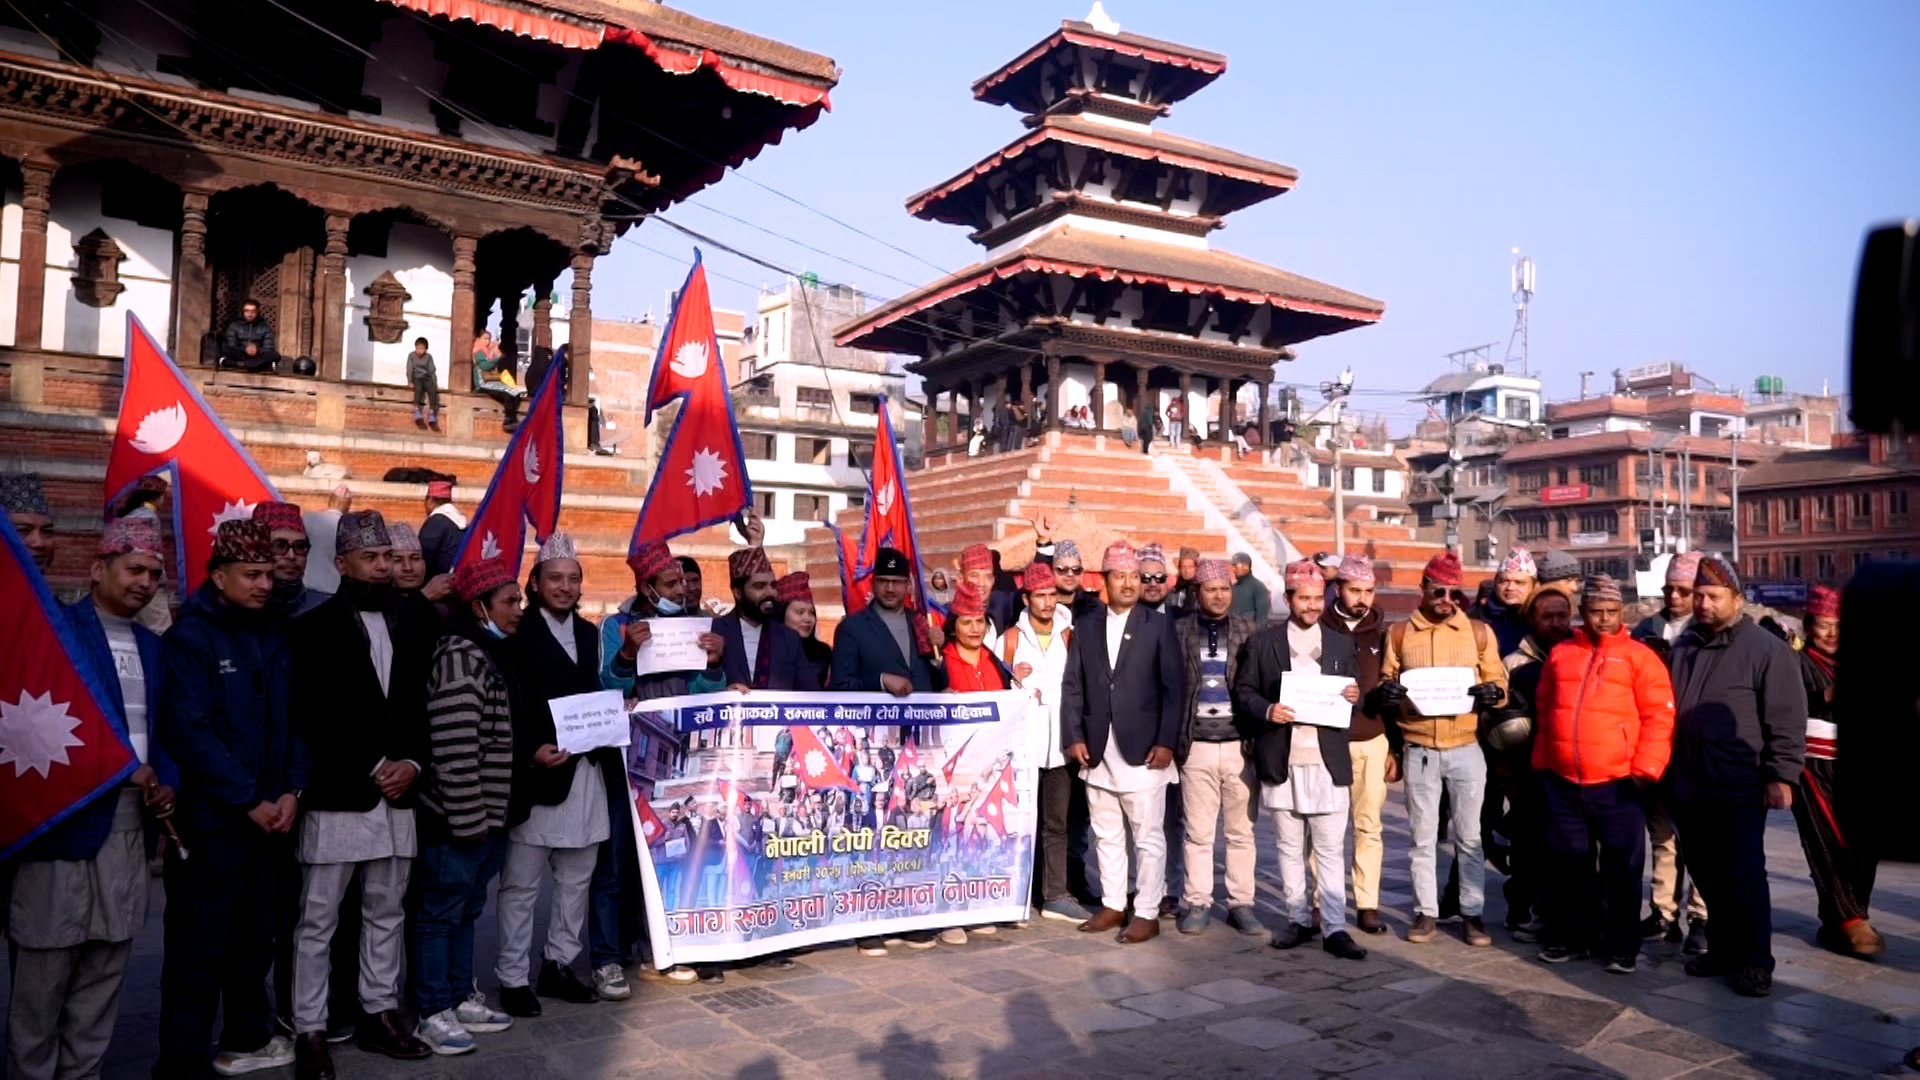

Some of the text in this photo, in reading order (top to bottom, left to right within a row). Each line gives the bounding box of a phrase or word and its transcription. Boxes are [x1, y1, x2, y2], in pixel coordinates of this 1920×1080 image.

[834, 705, 873, 720] नेपाली
[876, 705, 900, 720] टोपी
[904, 705, 948, 720] नेपालको
[766, 825, 931, 859] नेपाली टोपी दिवस
[784, 893, 826, 930] युवा
[833, 880, 937, 916] अभियान
[943, 873, 1012, 904] नेपाल
